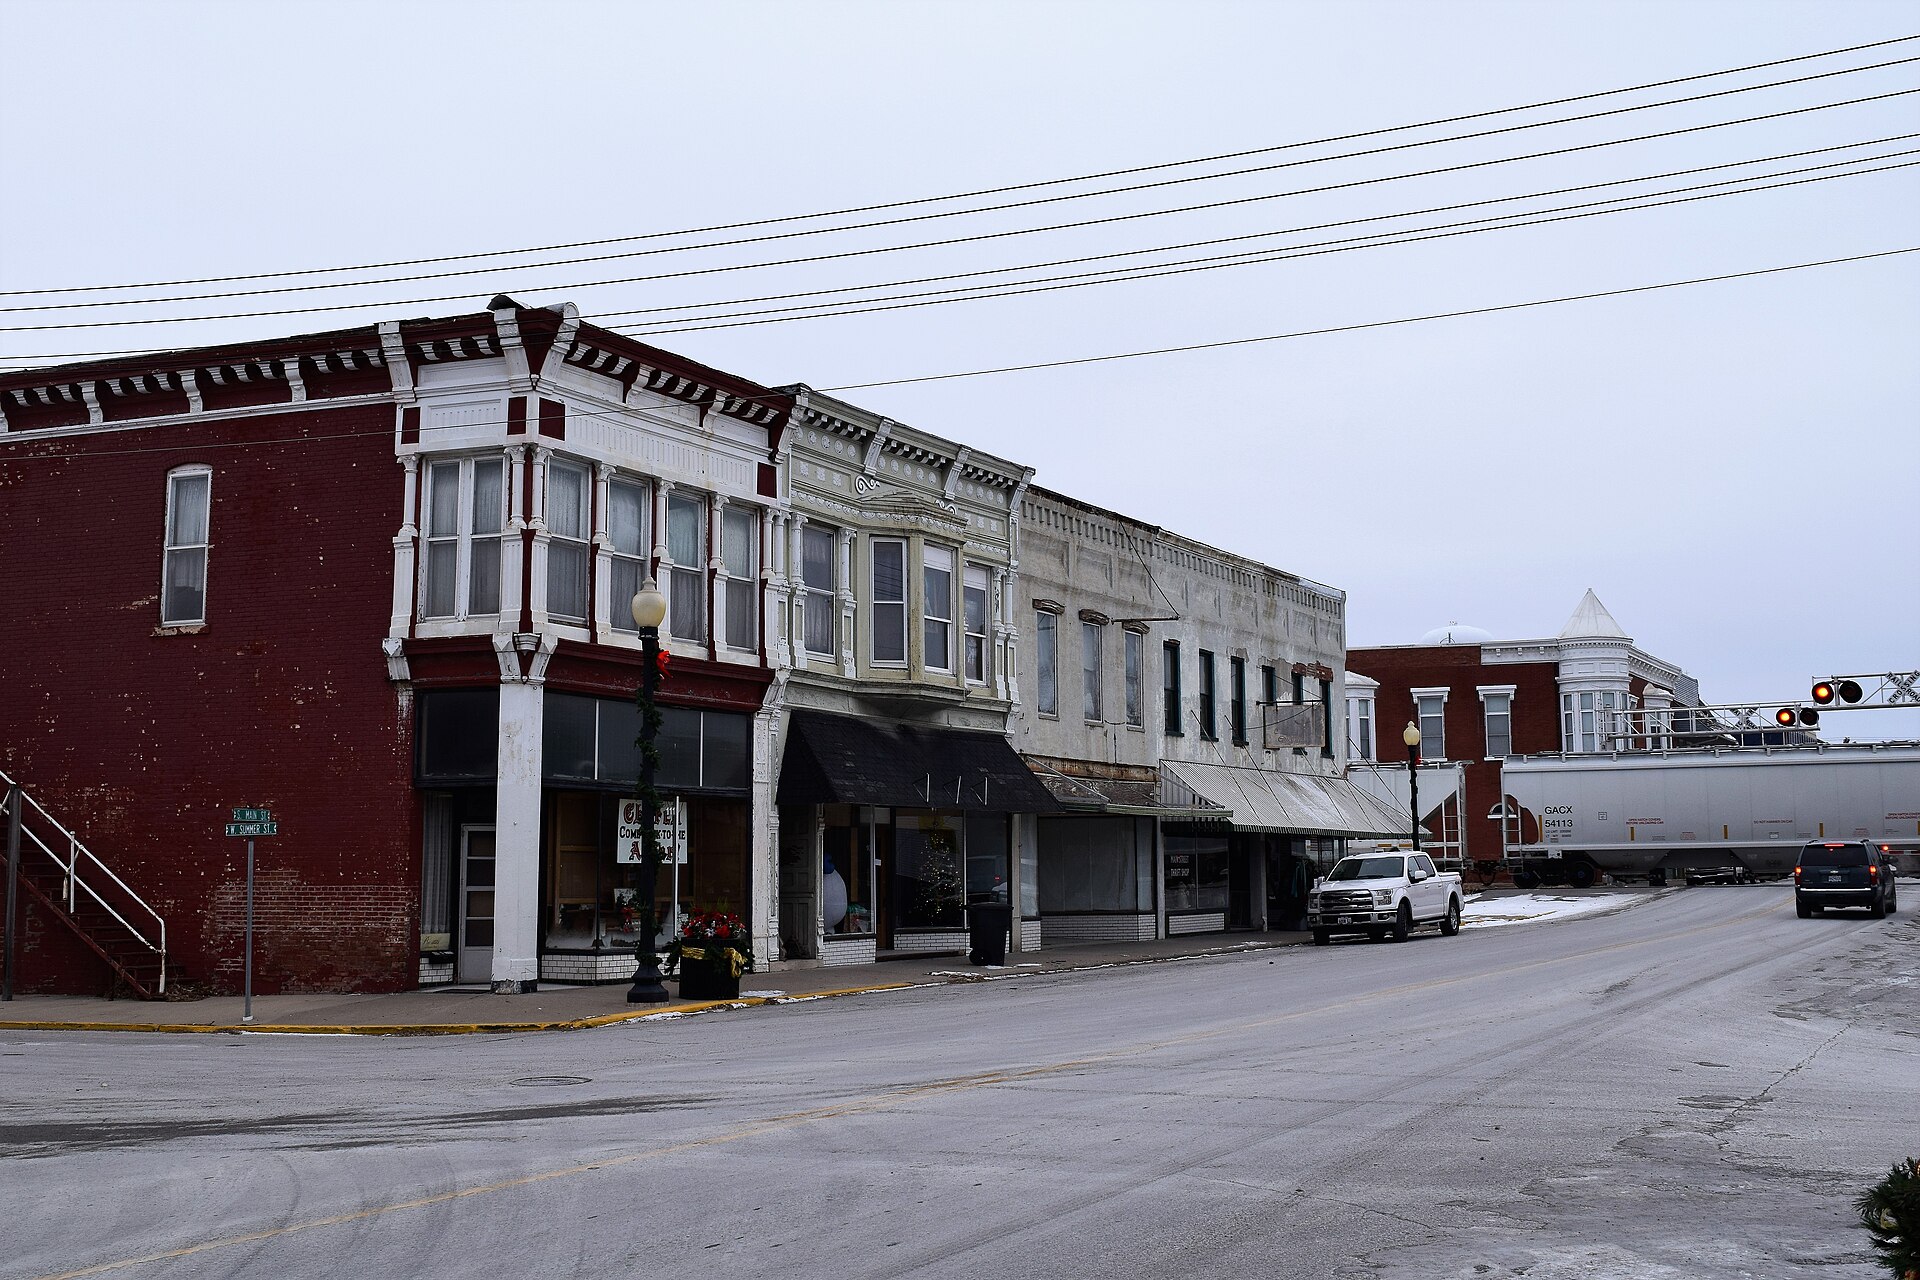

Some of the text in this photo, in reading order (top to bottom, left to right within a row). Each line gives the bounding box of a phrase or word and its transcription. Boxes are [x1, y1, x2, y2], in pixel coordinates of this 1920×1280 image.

[1886, 672, 1902, 687] RAIL
[1889, 671, 1920, 703] CROSSING
[245, 810, 257, 820] MAIN
[1544, 805, 1573, 815] GACX
[1544, 819, 1573, 828] 54113
[240, 824, 260, 835] SUMMER
